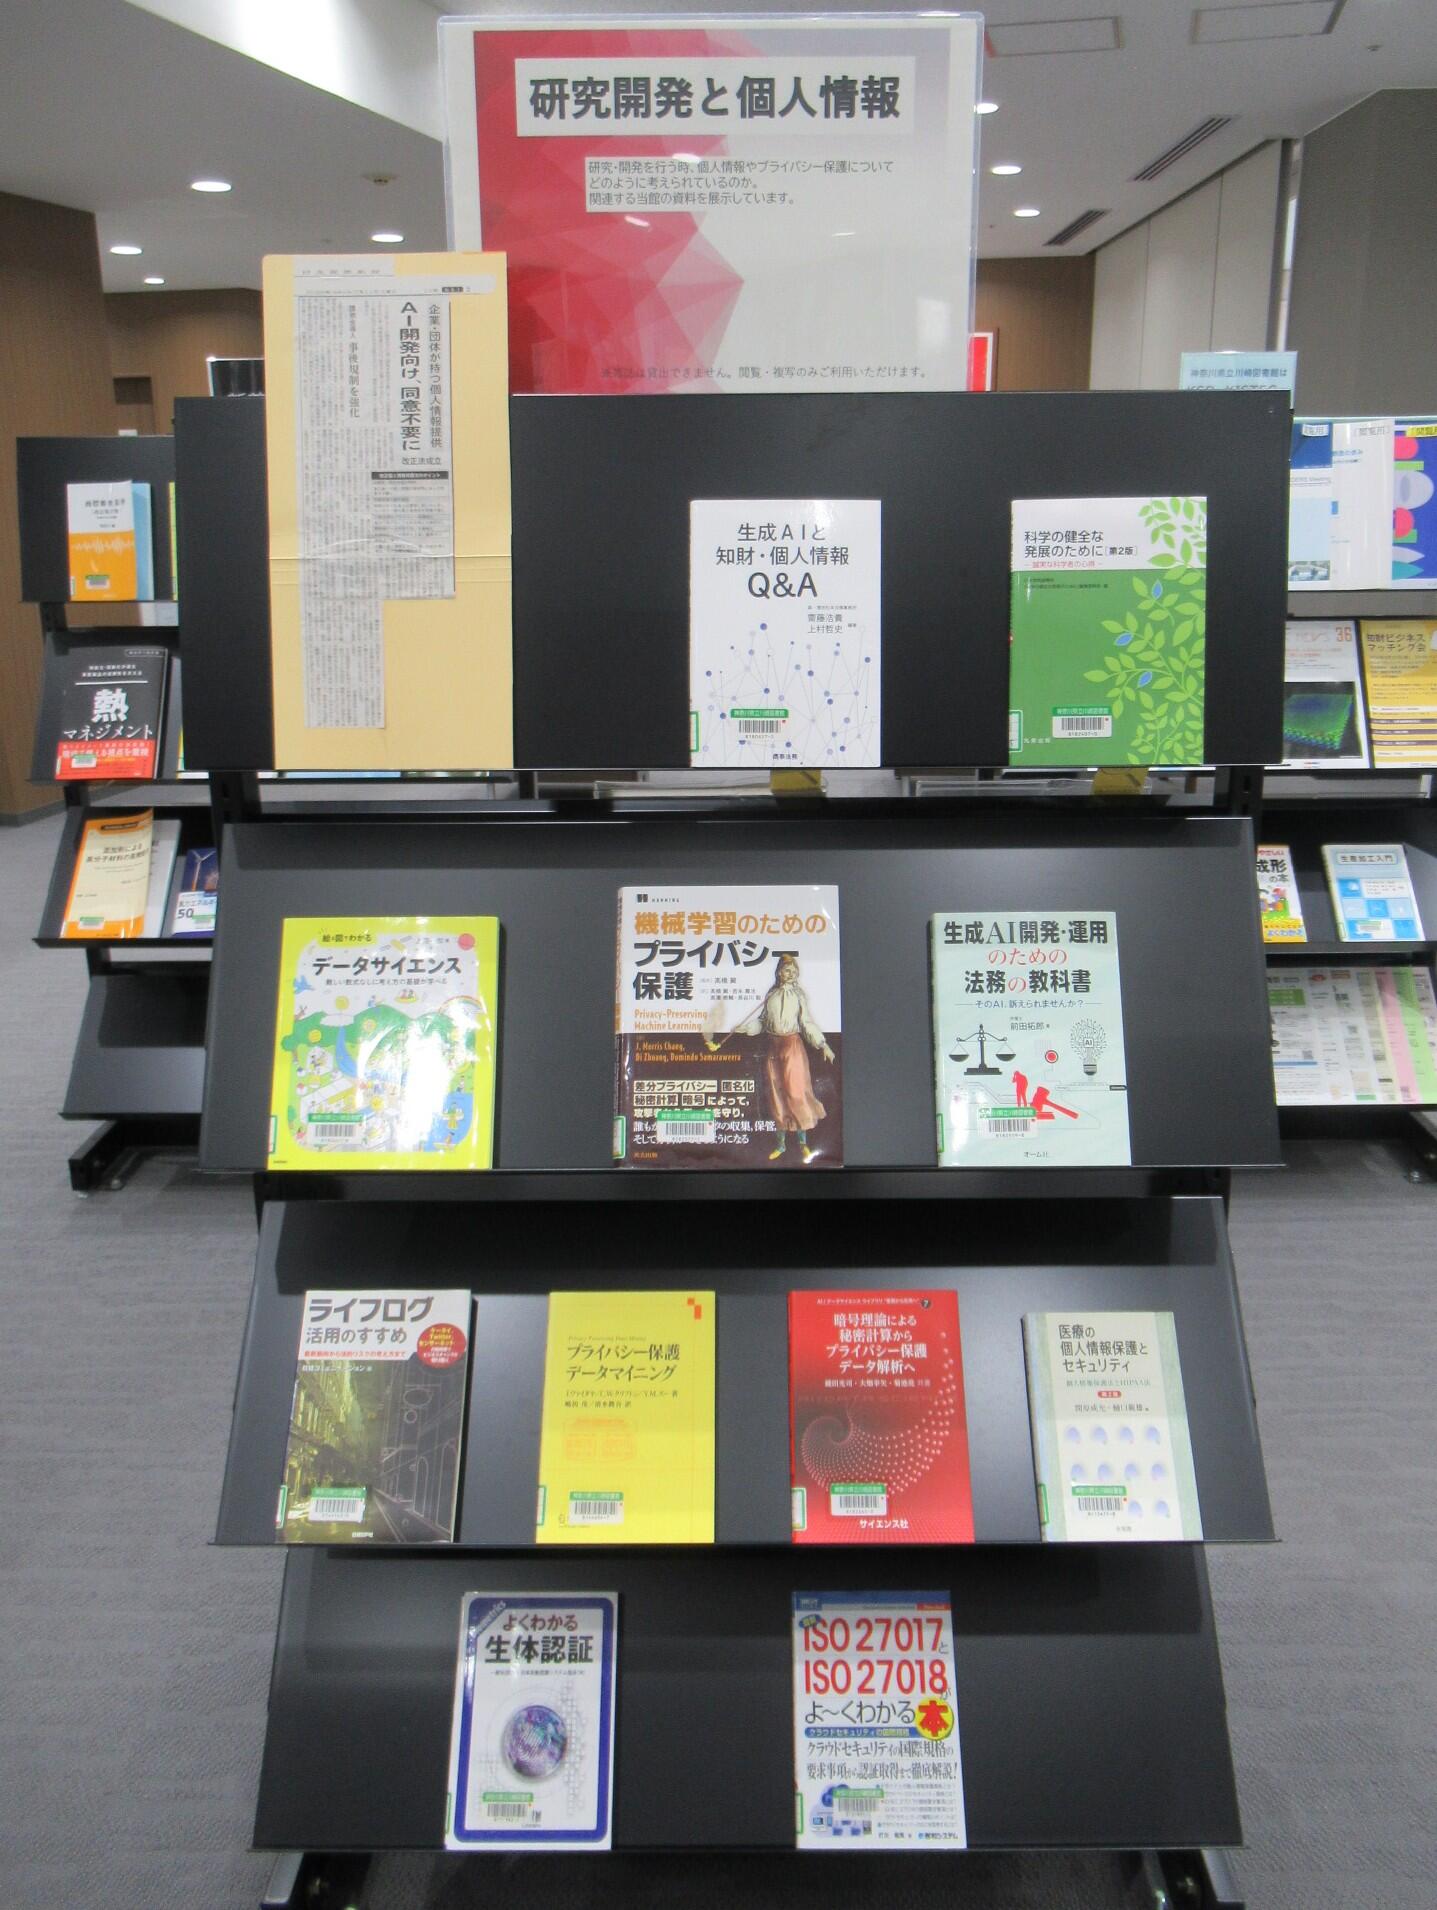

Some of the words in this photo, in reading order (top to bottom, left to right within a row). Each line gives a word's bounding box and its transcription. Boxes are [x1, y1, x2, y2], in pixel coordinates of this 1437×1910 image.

[528, 75, 901, 121] 研究開発と個人情報
[588, 159, 894, 175] 研究・開発を行う時、個人情報やプライバシー保護について
[588, 175, 759, 191] どのように考えられているのか。
[588, 191, 796, 207] 関連する当館の資料を展示しています。
[399, 301, 421, 452] AI開発向け、同意不要に
[1024, 530, 1104, 543] 科学の健全な
[715, 546, 850, 566] 知財・個人情報
[1024, 545, 1104, 558] 発展のために
[747, 572, 819, 599] Q&A
[91, 688, 129, 722] 熱
[63, 724, 153, 740] マネジメント
[177, 908, 194, 919] 50
[634, 911, 827, 936] 機械学習のための
[943, 920, 1108, 945] 生成AI開発・運用
[633, 939, 800, 967] プライバシー
[988, 948, 1068, 965] のための
[312, 956, 461, 976] データサイエンス
[632, 971, 694, 1001] 保護
[964, 969, 1092, 994] 法務の教科書
[634, 1021, 665, 1031] Machine
[635, 1081, 716, 1091] 差分プライバシー
[682, 1095, 704, 1105] 暗号
[309, 1297, 434, 1323] ライフログ
[833, 1313, 917, 1327] 暗号理論による
[306, 1327, 408, 1345] 活用のすすめ
[840, 1328, 912, 1343] 秘密計算から
[1058, 1325, 1096, 1339] 医療の
[567, 1343, 681, 1361] プライバシー保護
[826, 1343, 927, 1359] プライバシー保護
[1060, 1341, 1149, 1357] 個人情報保護と
[566, 1364, 678, 1382] データマイニング
[839, 1359, 915, 1375] データ解析へ
[1062, 1359, 1131, 1374] セキュリティ
[859, 1519, 909, 1529] サイエンス社
[502, 1614, 579, 1632] よくわかる
[803, 1617, 850, 1652] ISO
[855, 1617, 944, 1652] 27017
[485, 1635, 594, 1664] 生体認証
[804, 1659, 851, 1695] ISO
[856, 1658, 948, 1695] 27018
[917, 1700, 949, 1737] 本
